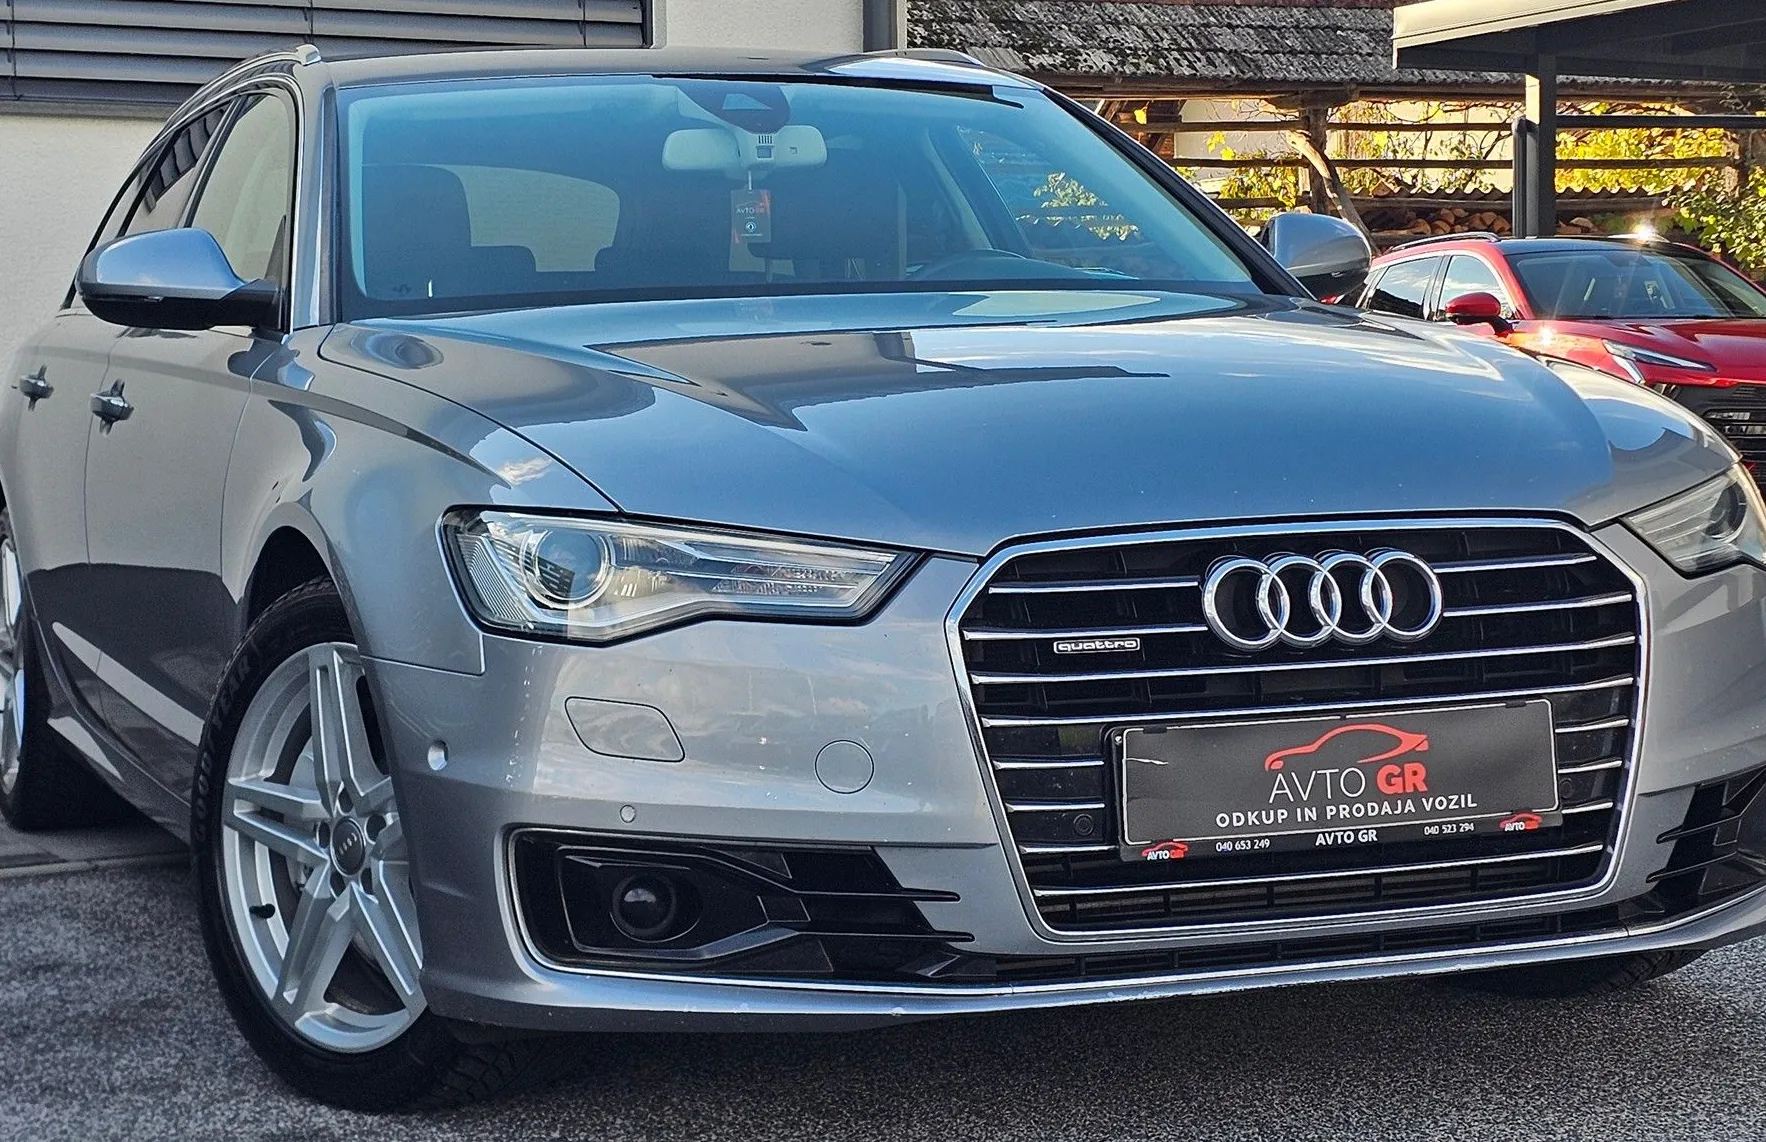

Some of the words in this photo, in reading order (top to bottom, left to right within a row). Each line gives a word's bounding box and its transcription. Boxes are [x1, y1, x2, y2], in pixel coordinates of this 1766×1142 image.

[1058, 641, 1137, 652] quattro
[1268, 767, 1366, 804] AVTO
[1376, 762, 1428, 795] GR
[1215, 809, 1288, 828] ODKUP
[1296, 806, 1317, 822] IN
[1326, 799, 1416, 820] PRODAJA
[1421, 793, 1478, 812] VOZIL
[1423, 825, 1440, 835] 040
[1441, 824, 1457, 834] 523
[1459, 822, 1475, 833] 294
[1504, 821, 1526, 832] AVTO
[1315, 830, 1355, 846] AVTO
[1357, 829, 1378, 843] GR
[1215, 841, 1233, 852] 040
[1234, 840, 1252, 851] 653
[1253, 838, 1270, 850] 249
[1146, 849, 1170, 861] AVTO
